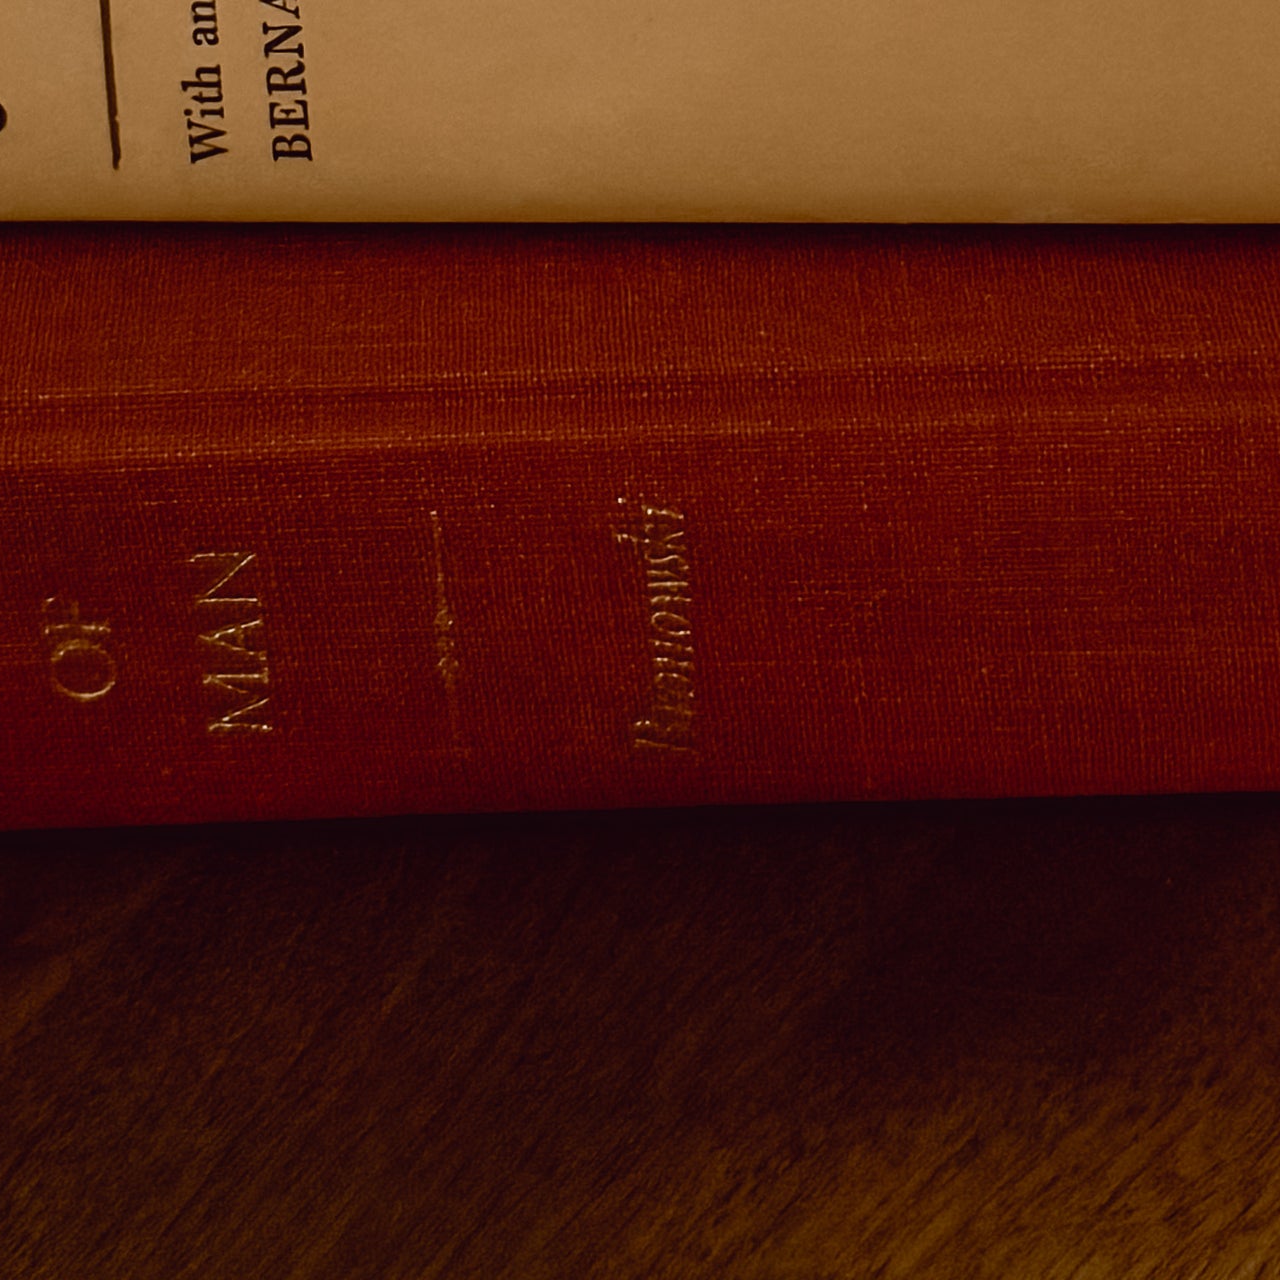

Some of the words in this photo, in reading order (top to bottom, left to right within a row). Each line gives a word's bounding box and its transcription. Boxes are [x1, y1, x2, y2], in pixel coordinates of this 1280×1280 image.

[184, 62, 227, 166] With
[44, 596, 115, 701] OF
[189, 551, 273, 734] MAN
